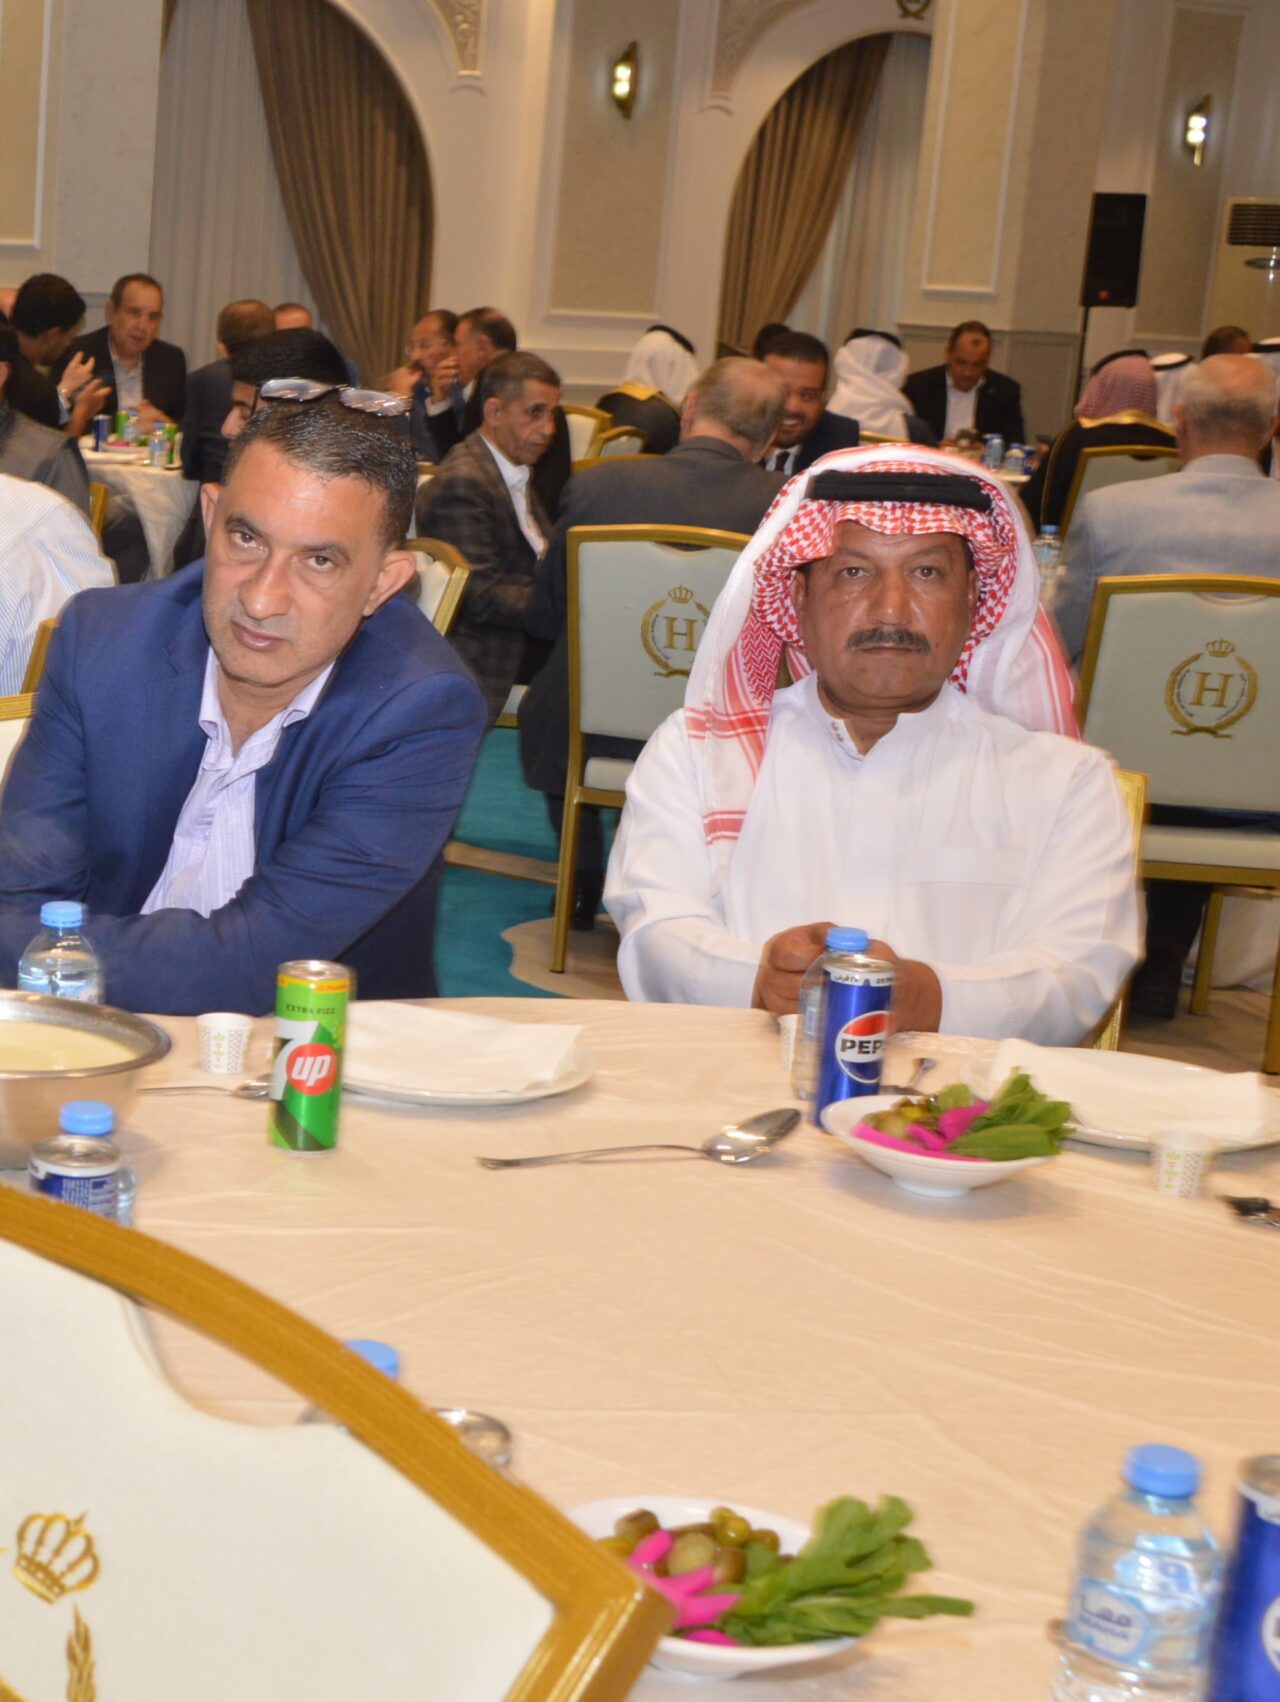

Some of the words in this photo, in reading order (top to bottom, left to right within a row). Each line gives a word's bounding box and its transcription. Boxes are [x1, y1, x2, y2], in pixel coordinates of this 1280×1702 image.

[1189, 671, 1235, 708] H
[286, 1003, 314, 1014] EXTRA
[840, 1038, 883, 1055] PEP
